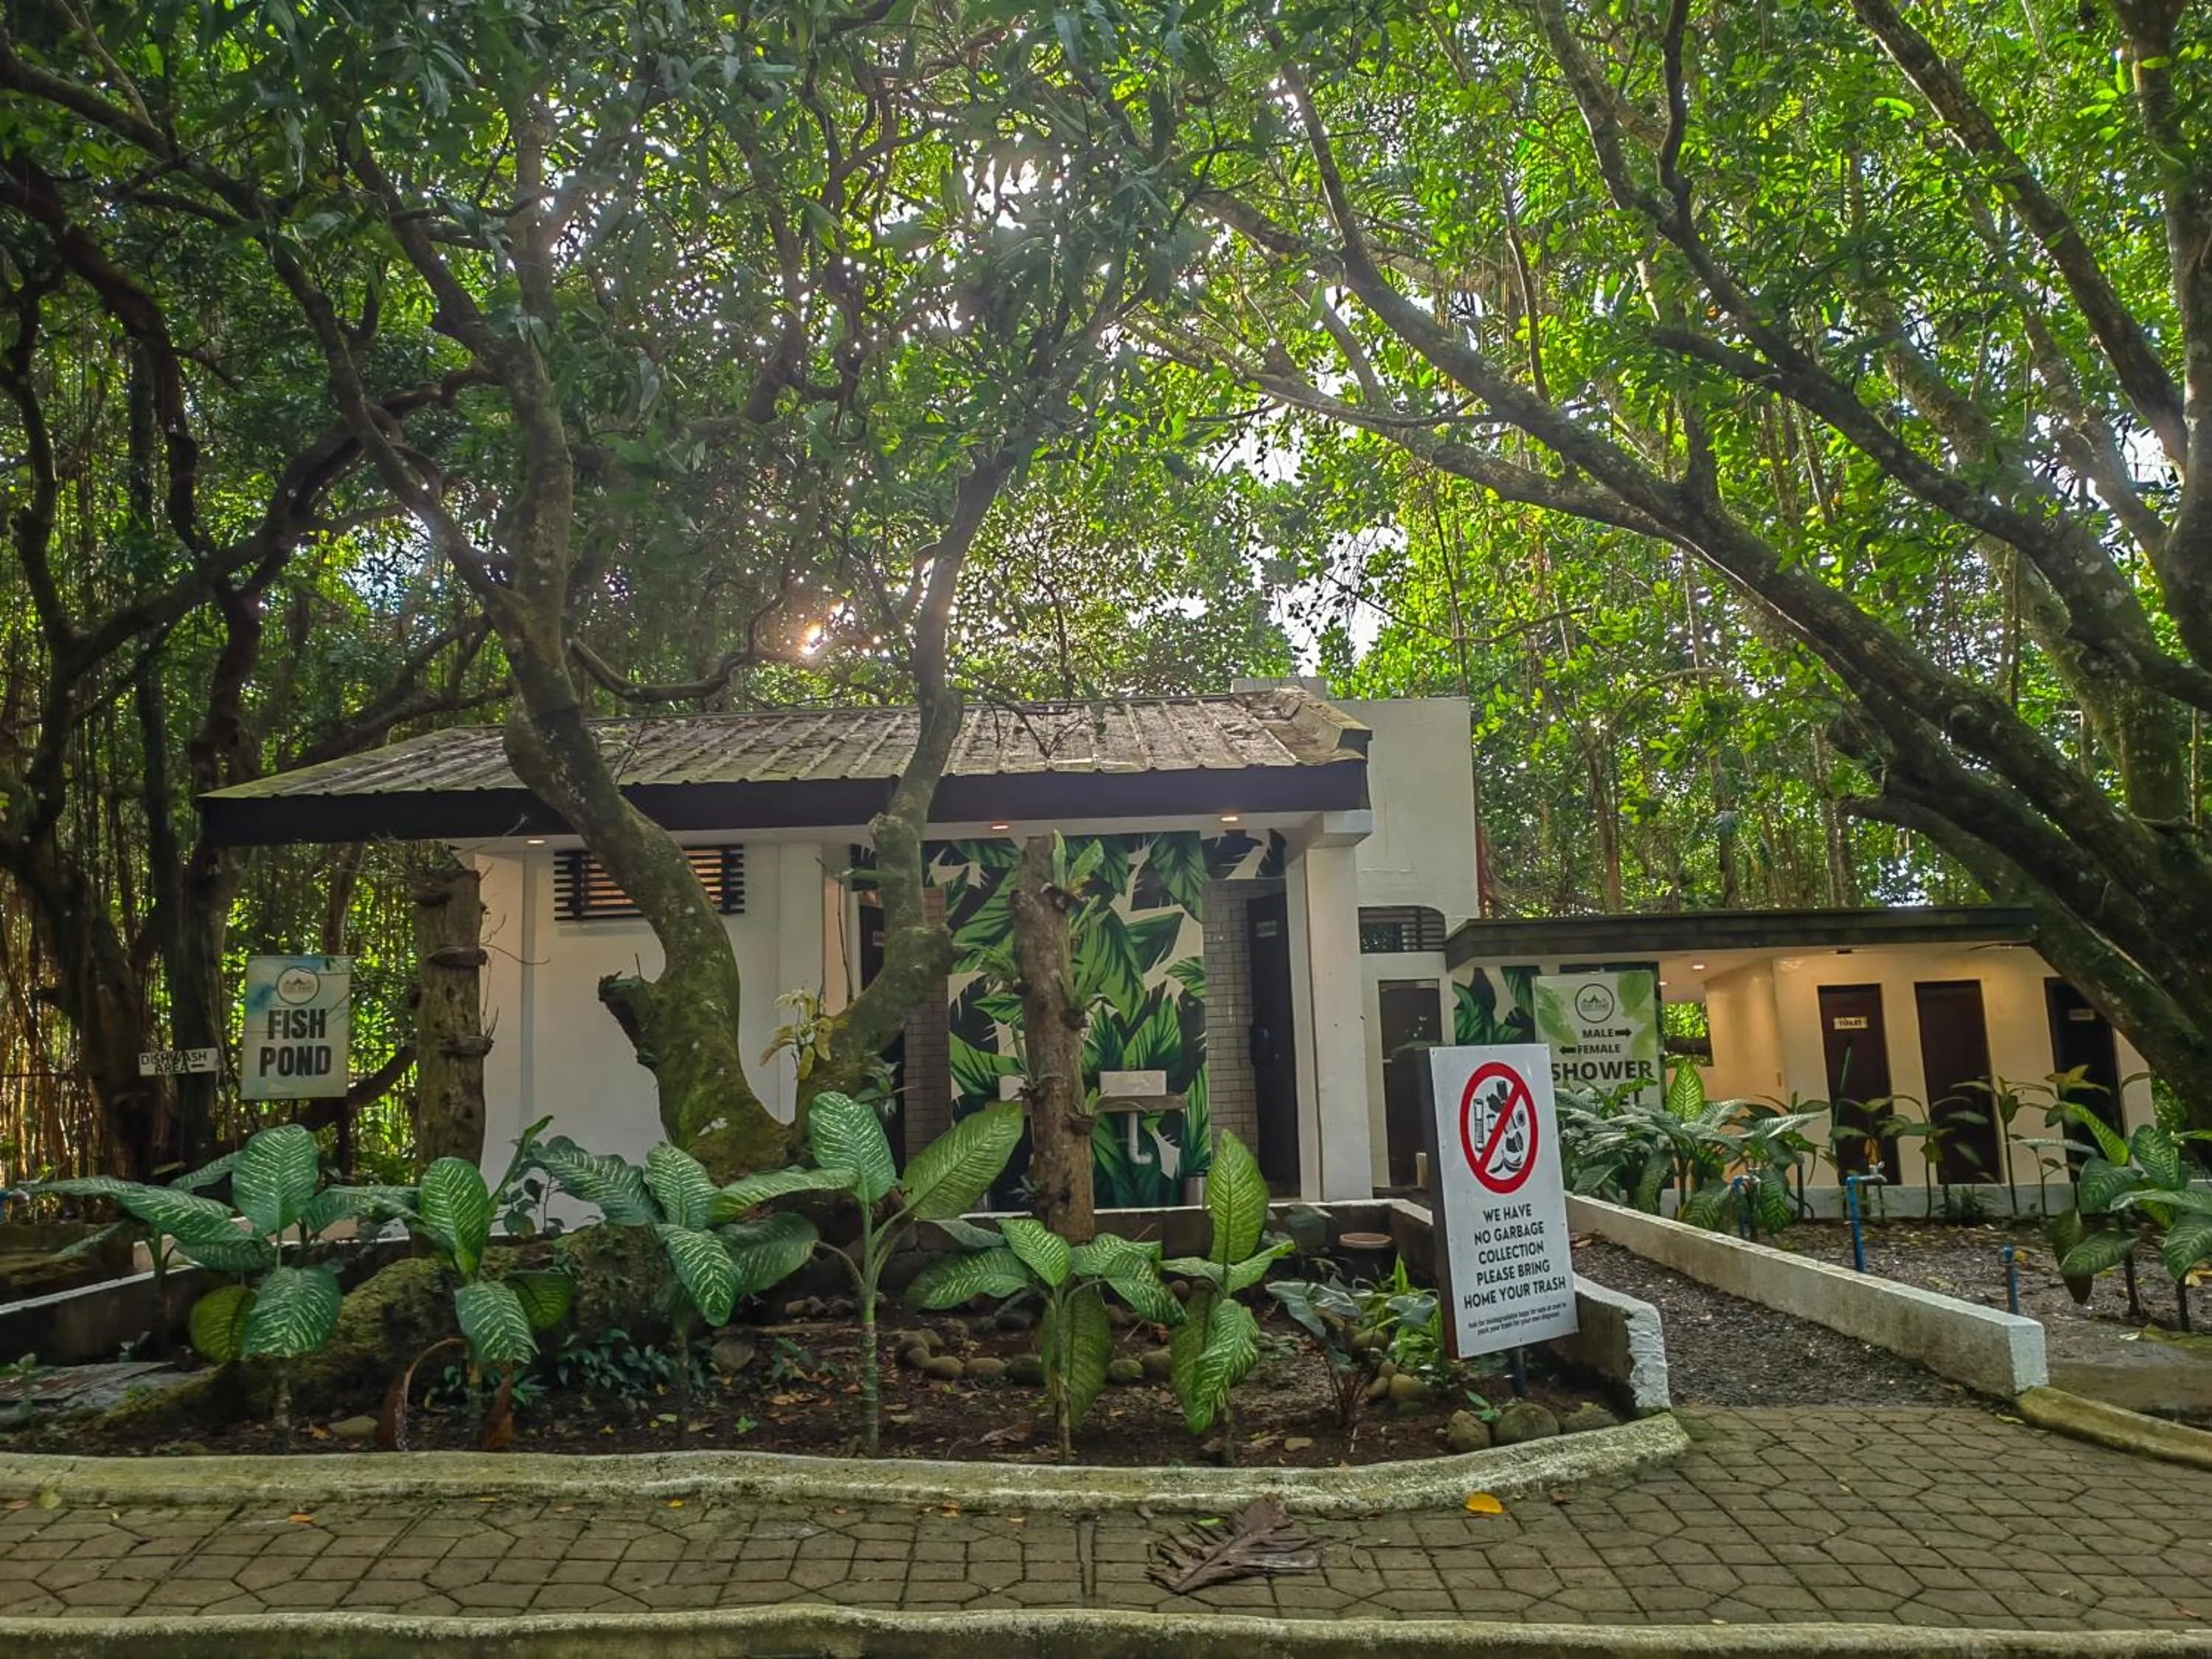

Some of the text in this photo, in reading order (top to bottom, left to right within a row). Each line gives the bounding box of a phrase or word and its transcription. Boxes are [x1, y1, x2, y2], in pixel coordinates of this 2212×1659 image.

[268, 1009, 326, 1039] FISH
[1582, 1029, 1615, 1038] MALE
[1577, 1043, 1621, 1054] FEMALE
[259, 1046, 331, 1077] POND
[1551, 1060, 1655, 1082] SHOWER
[1483, 1203, 1532, 1222] WE HAVE
[1475, 1221, 1545, 1245] NO GARBAGE
[1478, 1240, 1545, 1265] COLLECTION
[1477, 1259, 1550, 1286] PLEASE BRING
[1464, 1276, 1566, 1310] HOME YOUR TRASH
